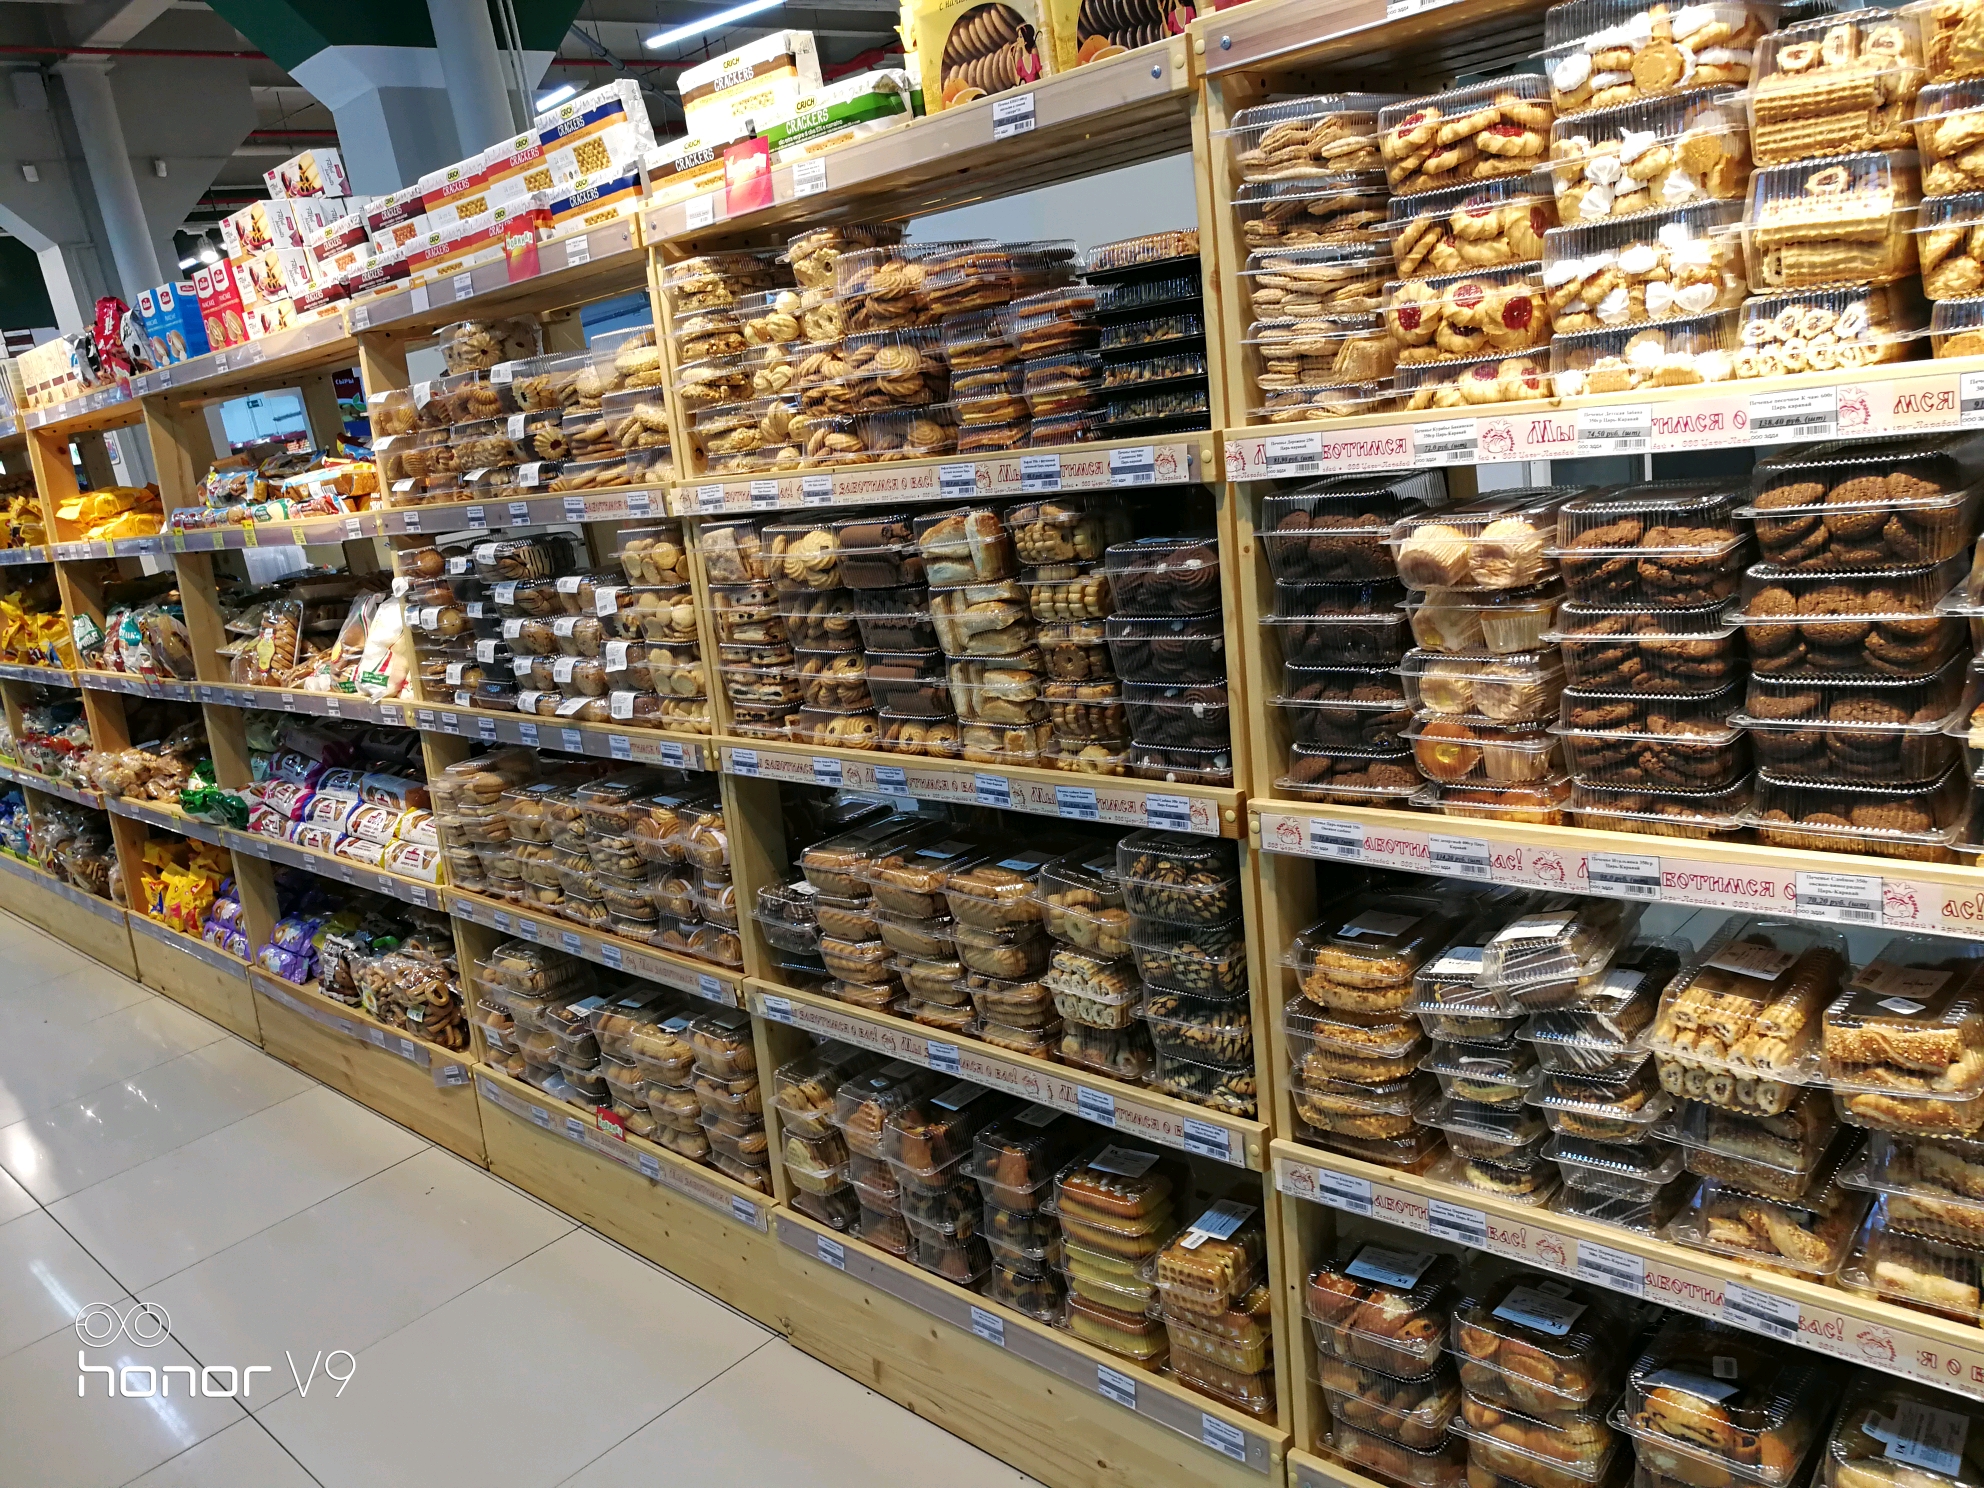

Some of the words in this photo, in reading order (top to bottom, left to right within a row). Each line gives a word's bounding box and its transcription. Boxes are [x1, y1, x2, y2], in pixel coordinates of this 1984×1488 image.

[724, 56, 740, 70] CRICH
[714, 67, 754, 92] CRACKERS
[797, 98, 814, 110] CRICH
[560, 106, 572, 117] CRICH
[557, 116, 585, 136] CRACKERS
[786, 109, 828, 134] CRACKERS
[515, 138, 528, 150] CRICH
[510, 147, 540, 166] CRACKERS
[675, 148, 714, 172] CRACKERS
[447, 170, 460, 180] CRICH
[442, 179, 470, 196] CRACKERS
[575, 178, 588, 189] CRICH
[570, 188, 600, 208] CRACKERS
[382, 206, 402, 220] CRACKERS
[494, 208, 506, 221] CRICH
[323, 236, 342, 250] CRACKERS
[430, 234, 440, 244] CRICH
[424, 243, 450, 260] CRACKERS
[362, 268, 384, 282] CRACKERS
[305, 290, 324, 304] CRACKERS
[335, 376, 354, 384] СЫРЫ
[1527, 420, 1574, 444] Мы
[1606, 430, 1619, 438] руб.
